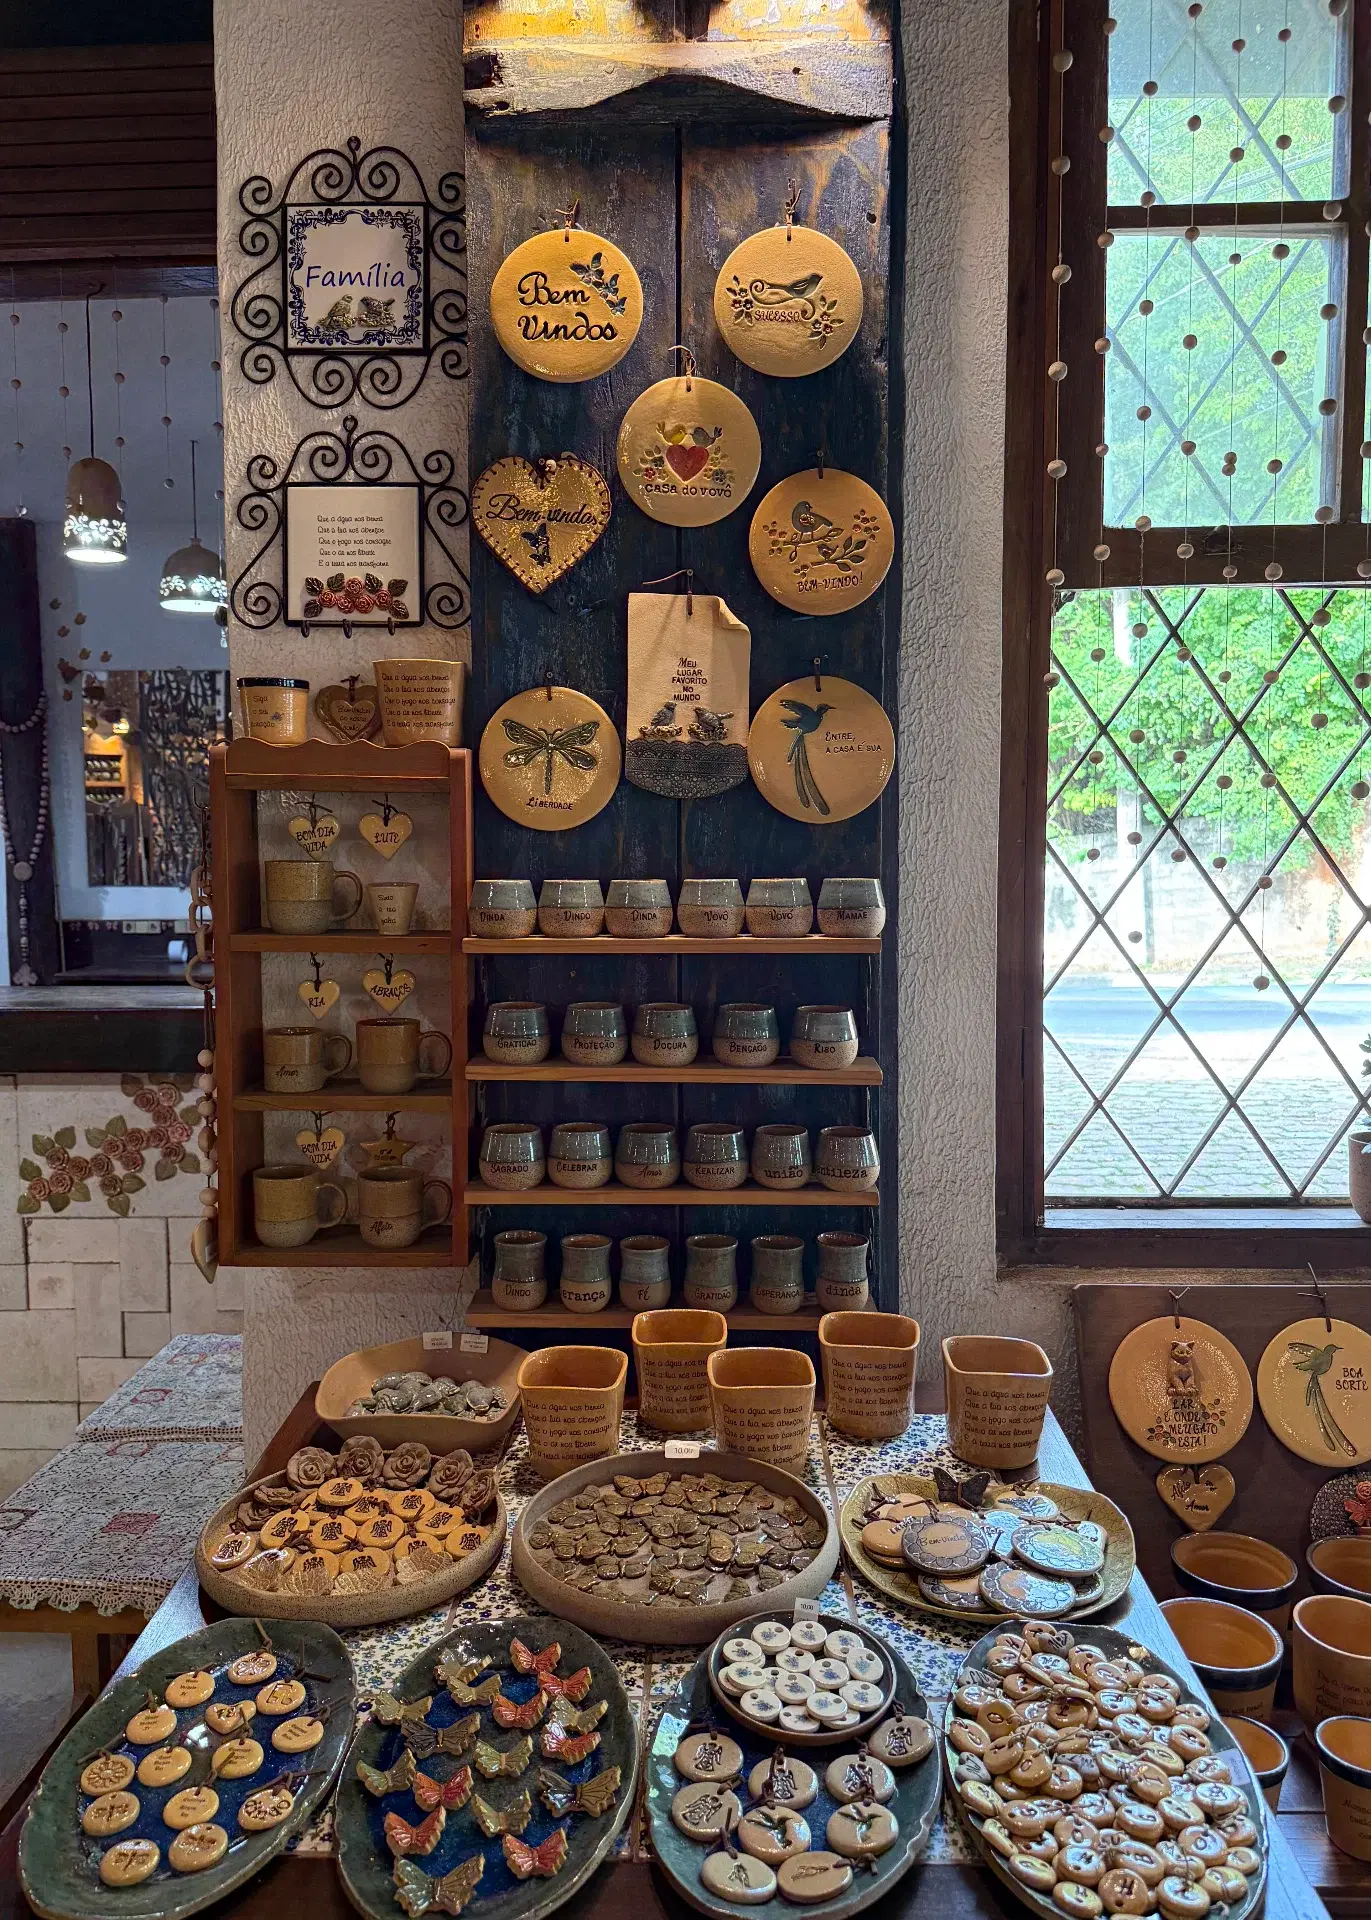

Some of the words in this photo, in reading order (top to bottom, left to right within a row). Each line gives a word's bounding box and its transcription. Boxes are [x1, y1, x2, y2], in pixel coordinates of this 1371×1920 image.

[305, 263, 406, 288] Família
[517, 271, 590, 306] Bem
[754, 310, 800, 322] SUCESSO
[517, 312, 617, 341] Vindos
[644, 483, 678, 494] casa
[682, 485, 698, 496] do
[700, 485, 732, 498] vovô
[486, 494, 598, 525] Bem-vindos
[796, 571, 864, 592] BEM-VINDO!
[678, 657, 697, 668] MEU
[676, 668, 703, 677] LUGAR
[673, 693, 701, 701] MUNDO
[825, 731, 855, 742] ENTRE,
[833, 746, 854, 754] CASA
[858, 740, 866, 752] É
[296, 829, 317, 842] BOM
[318, 826, 336, 838] DIA
[374, 832, 400, 844] LUTE
[303, 841, 328, 852] VIDA
[370, 983, 411, 1000] ABRAÇOS
[308, 997, 325, 1008] RIA
[498, 1036, 537, 1049] GRATIDÃO
[574, 1039, 615, 1050] PROTEÇÃO
[653, 1040, 687, 1051] DOÇURA
[814, 1042, 836, 1054] RISO
[321, 1141, 338, 1152] DIA
[310, 1153, 332, 1164] VIDA
[490, 1164, 529, 1174] SAGRADO
[556, 1162, 598, 1173] CELEBRAR
[638, 1165, 663, 1177] Amor
[695, 1166, 735, 1176] REALIZAR
[764, 1166, 804, 1179] união
[694, 1287, 732, 1300] GRATIDÃO
[756, 1286, 800, 1301] ESPERANÇA
[825, 1284, 862, 1297] dinda
[1342, 1367, 1364, 1378] BOA
[1336, 1379, 1369, 1391] SORTE
[722, 1404, 737, 1413] Que
[748, 1406, 766, 1417] água
[784, 1405, 803, 1414] benza
[1172, 1399, 1194, 1410] LAR
[724, 1416, 738, 1426] Que
[776, 1418, 804, 1427] abençoe
[1174, 1411, 1200, 1422] ONDE
[724, 1428, 738, 1438] Que
[746, 1433, 765, 1441] fogo
[782, 1426, 808, 1439] consagre
[1169, 1424, 1191, 1435] MEU
[1193, 1423, 1218, 1435] GATO
[724, 1440, 738, 1449] Que
[774, 1451, 803, 1464] transforme
